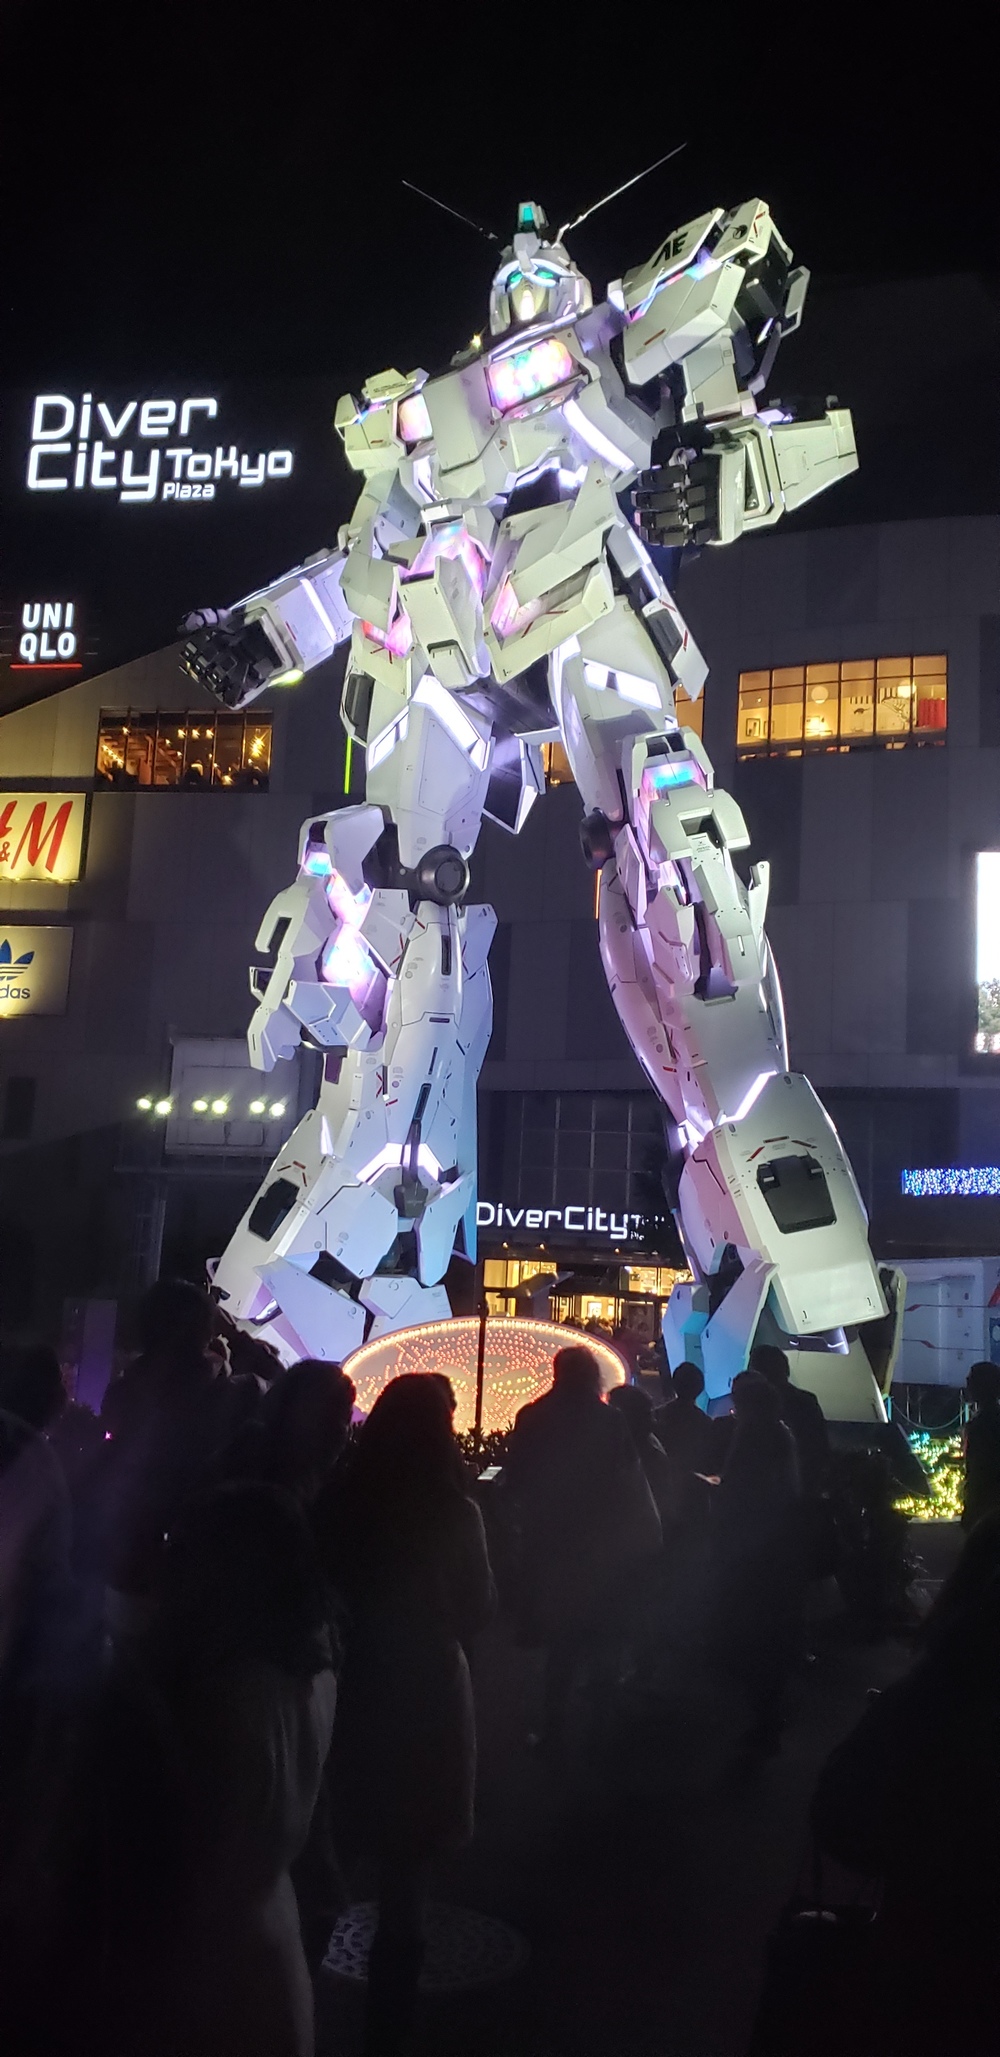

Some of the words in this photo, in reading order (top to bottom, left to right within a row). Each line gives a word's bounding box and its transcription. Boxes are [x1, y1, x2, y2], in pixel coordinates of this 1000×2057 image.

[31, 393, 218, 441] Diver
[27, 441, 160, 502] City
[162, 482, 215, 499] Plaza
[22, 602, 75, 629] UNI
[19, 632, 76, 662] QLO
[476, 1201, 628, 1240] DiverCity
